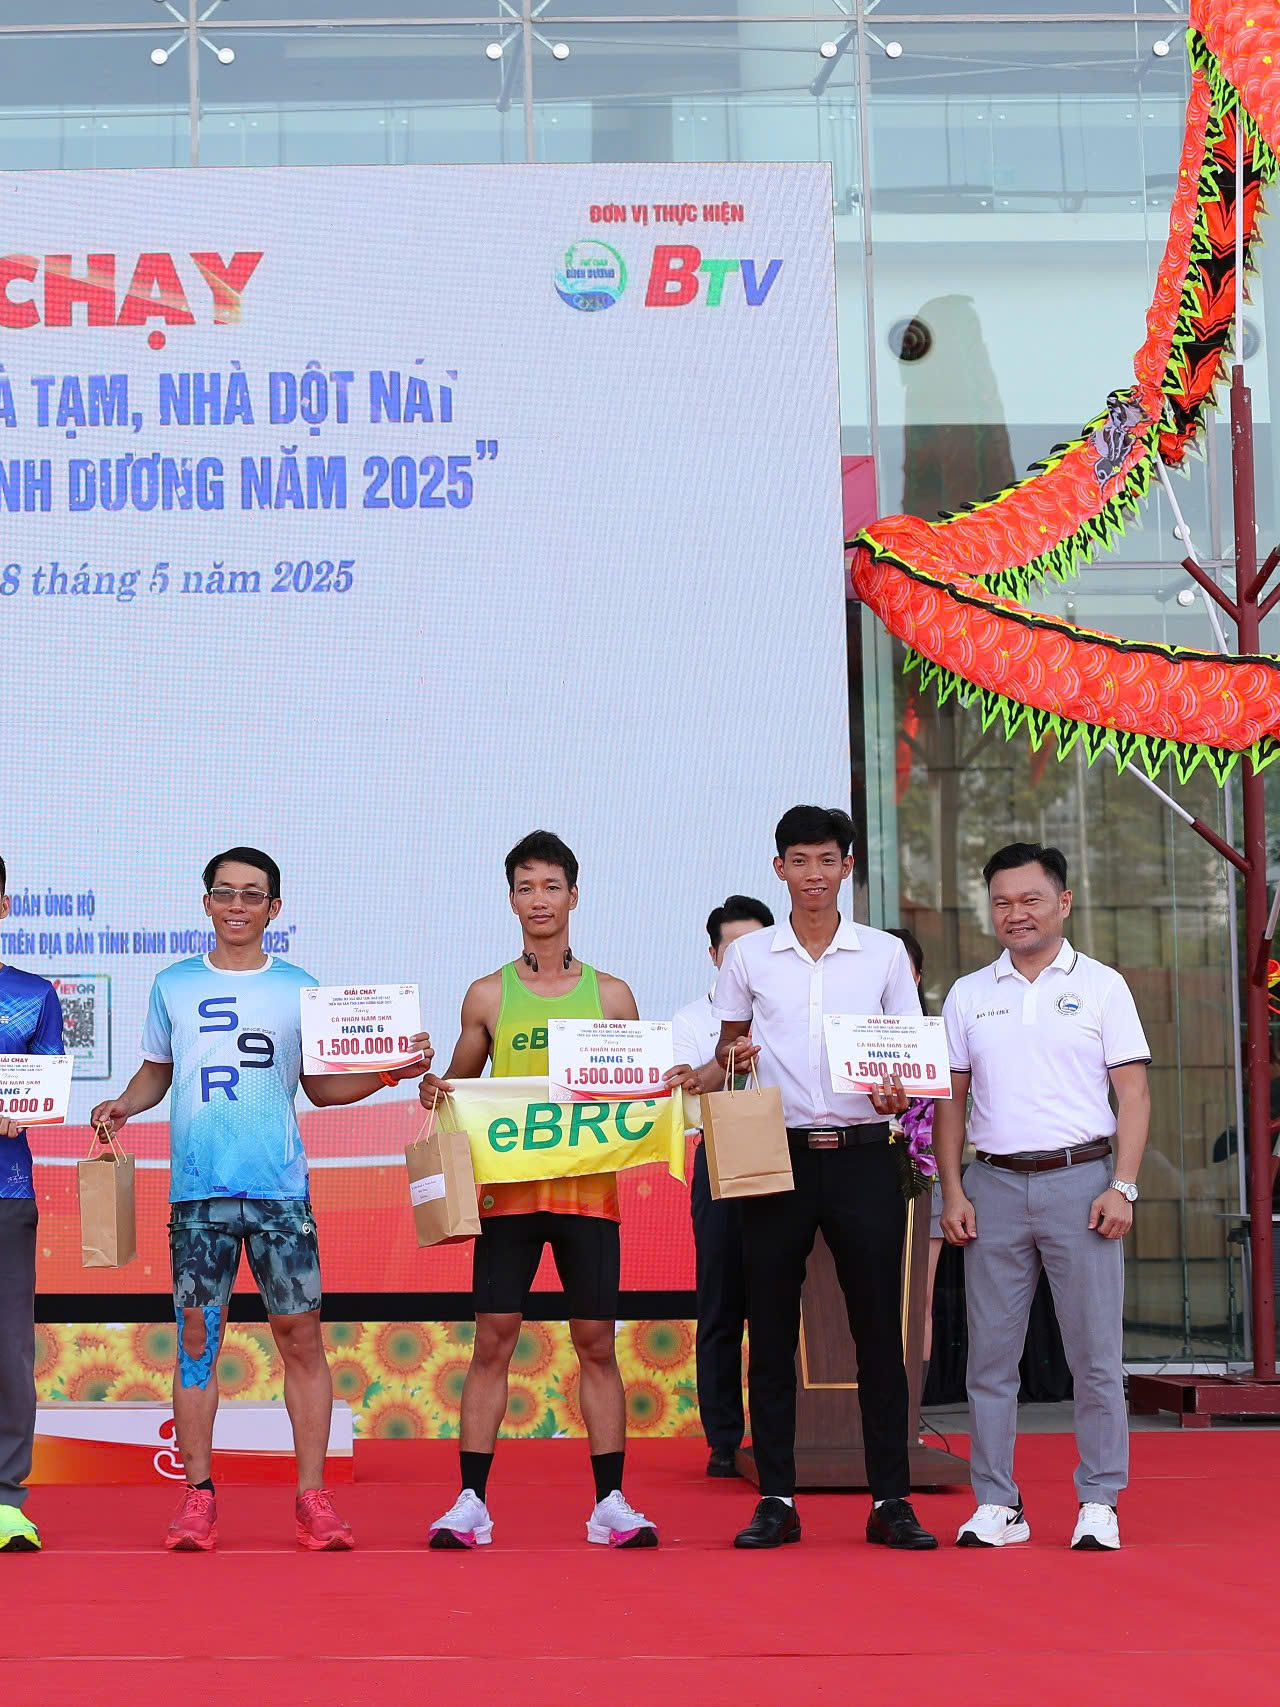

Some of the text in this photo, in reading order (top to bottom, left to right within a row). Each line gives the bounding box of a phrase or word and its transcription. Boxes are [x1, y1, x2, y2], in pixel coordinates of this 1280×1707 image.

[590, 202, 744, 226] ĐƠN VỊ THỰC HIỆN
[645, 245, 783, 307] BTV
[32, 374, 143, 439] TẠM,
[160, 360, 254, 426] NHÀ
[269, 360, 354, 436] DỘT
[69, 452, 224, 512] DƯƠNG
[241, 444, 346, 510] NĂM
[362, 440, 499, 510] 2025”
[31, 562, 141, 602] tháng
[150, 562, 169, 594] 5
[180, 561, 261, 594] năm
[271, 560, 355, 594] 2025
[77, 889, 95, 922] HỘ
[1, 928, 35, 955] TRÊN
[39, 932, 62, 959] ĐỊA
[66, 928, 94, 954] BÀN
[98, 926, 129, 954] TỈNH
[133, 927, 166, 954] BÌNH
[170, 929, 216, 954] DƯƠNG
[198, 996, 238, 1033] S
[342, 1024, 384, 1035] HẠNG 6
[237, 1032, 274, 1068] 9
[317, 1036, 409, 1056] 1.500.000 Đ
[590, 1056, 623, 1064] HẠNG
[868, 1050, 900, 1060] HẠNG
[201, 1066, 240, 1102] R
[564, 1067, 660, 1084] 1.500.000 Đ
[926, 1064, 936, 1080] Đ
[43, 1098, 54, 1112] Đ
